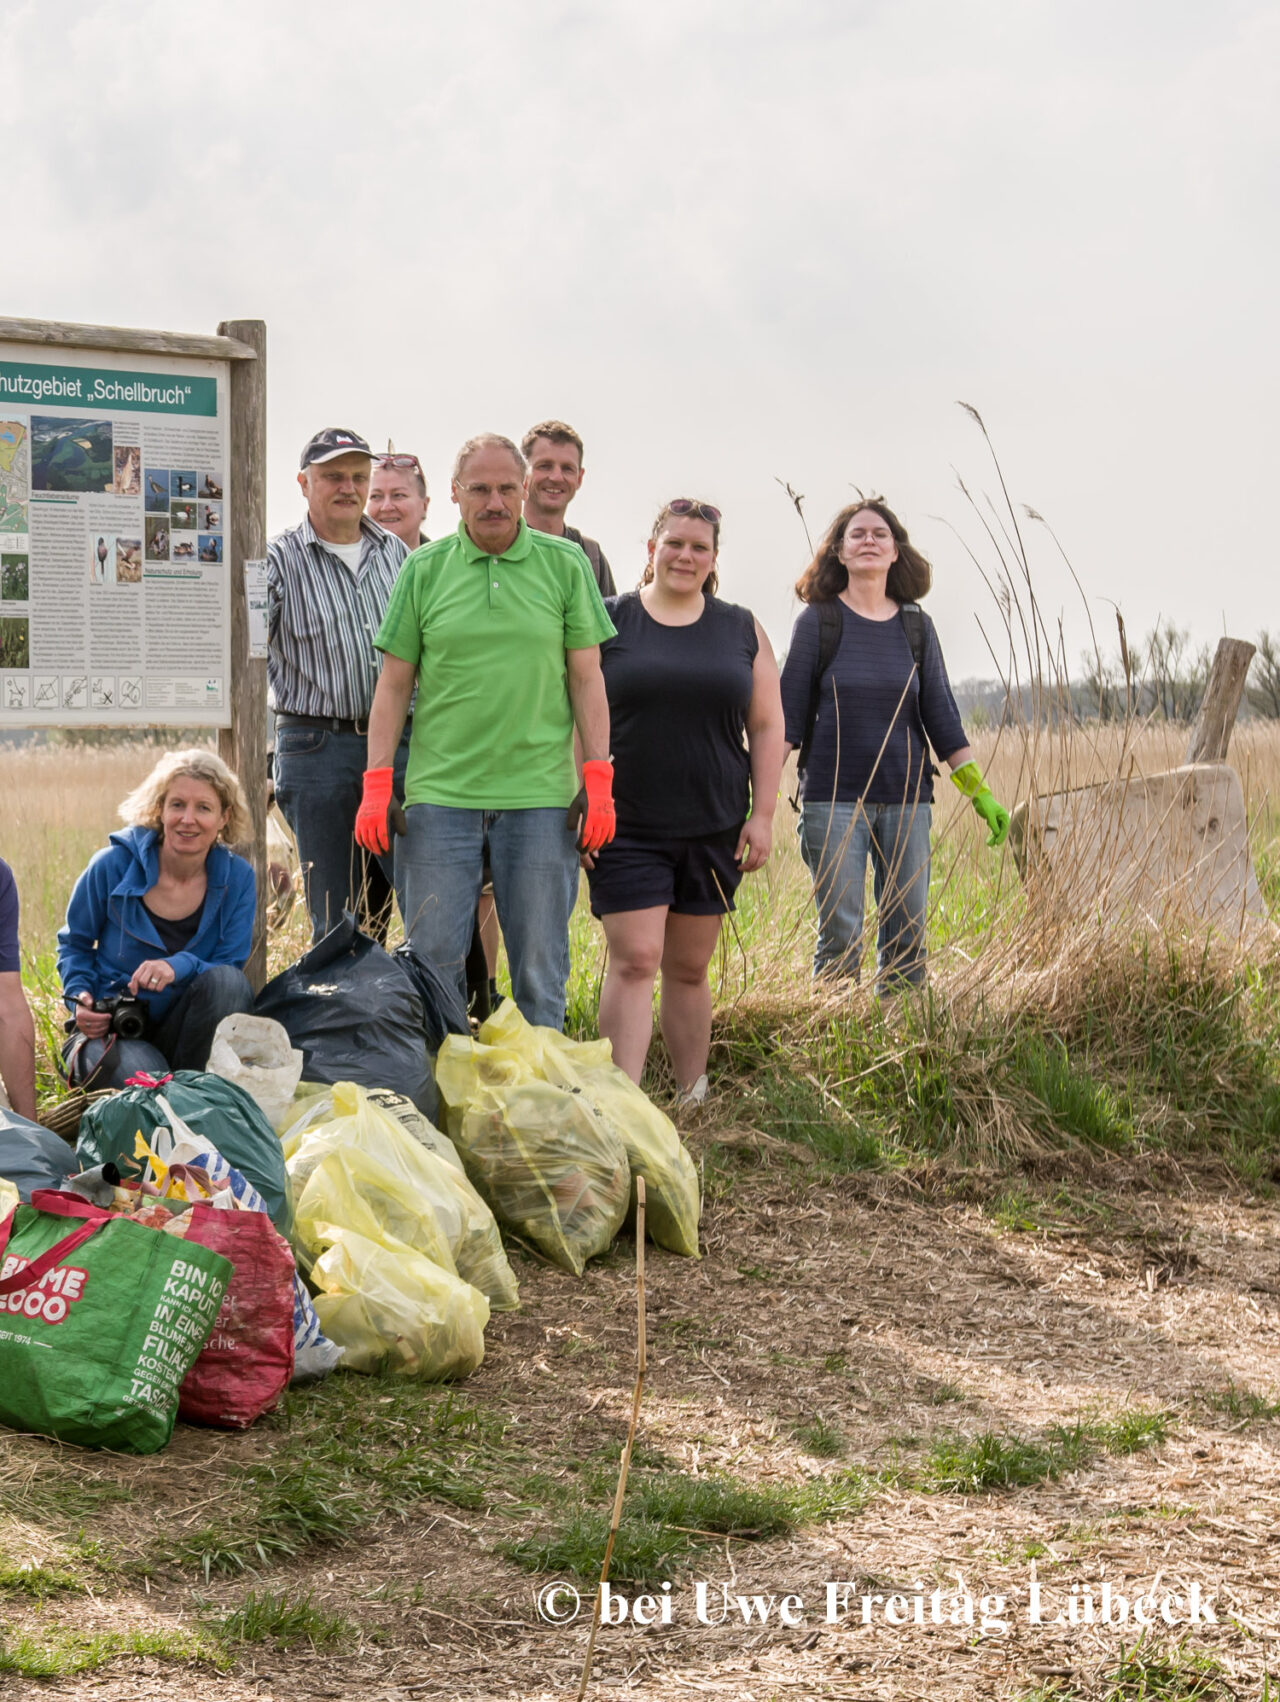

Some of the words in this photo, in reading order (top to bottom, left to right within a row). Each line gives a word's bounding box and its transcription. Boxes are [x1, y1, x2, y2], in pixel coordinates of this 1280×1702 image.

[87, 379, 191, 405] „Schellbruch“
[170, 1259, 207, 1288] BIN
[160, 1294, 182, 1309] KANN
[163, 1277, 217, 1318] KAPUT
[154, 1303, 175, 1323] IN
[14, 1334, 32, 1345] 1974
[149, 1320, 188, 1347] BLUME
[202, 1334, 239, 1350] sche.
[133, 1368, 161, 1385] GEGEN
